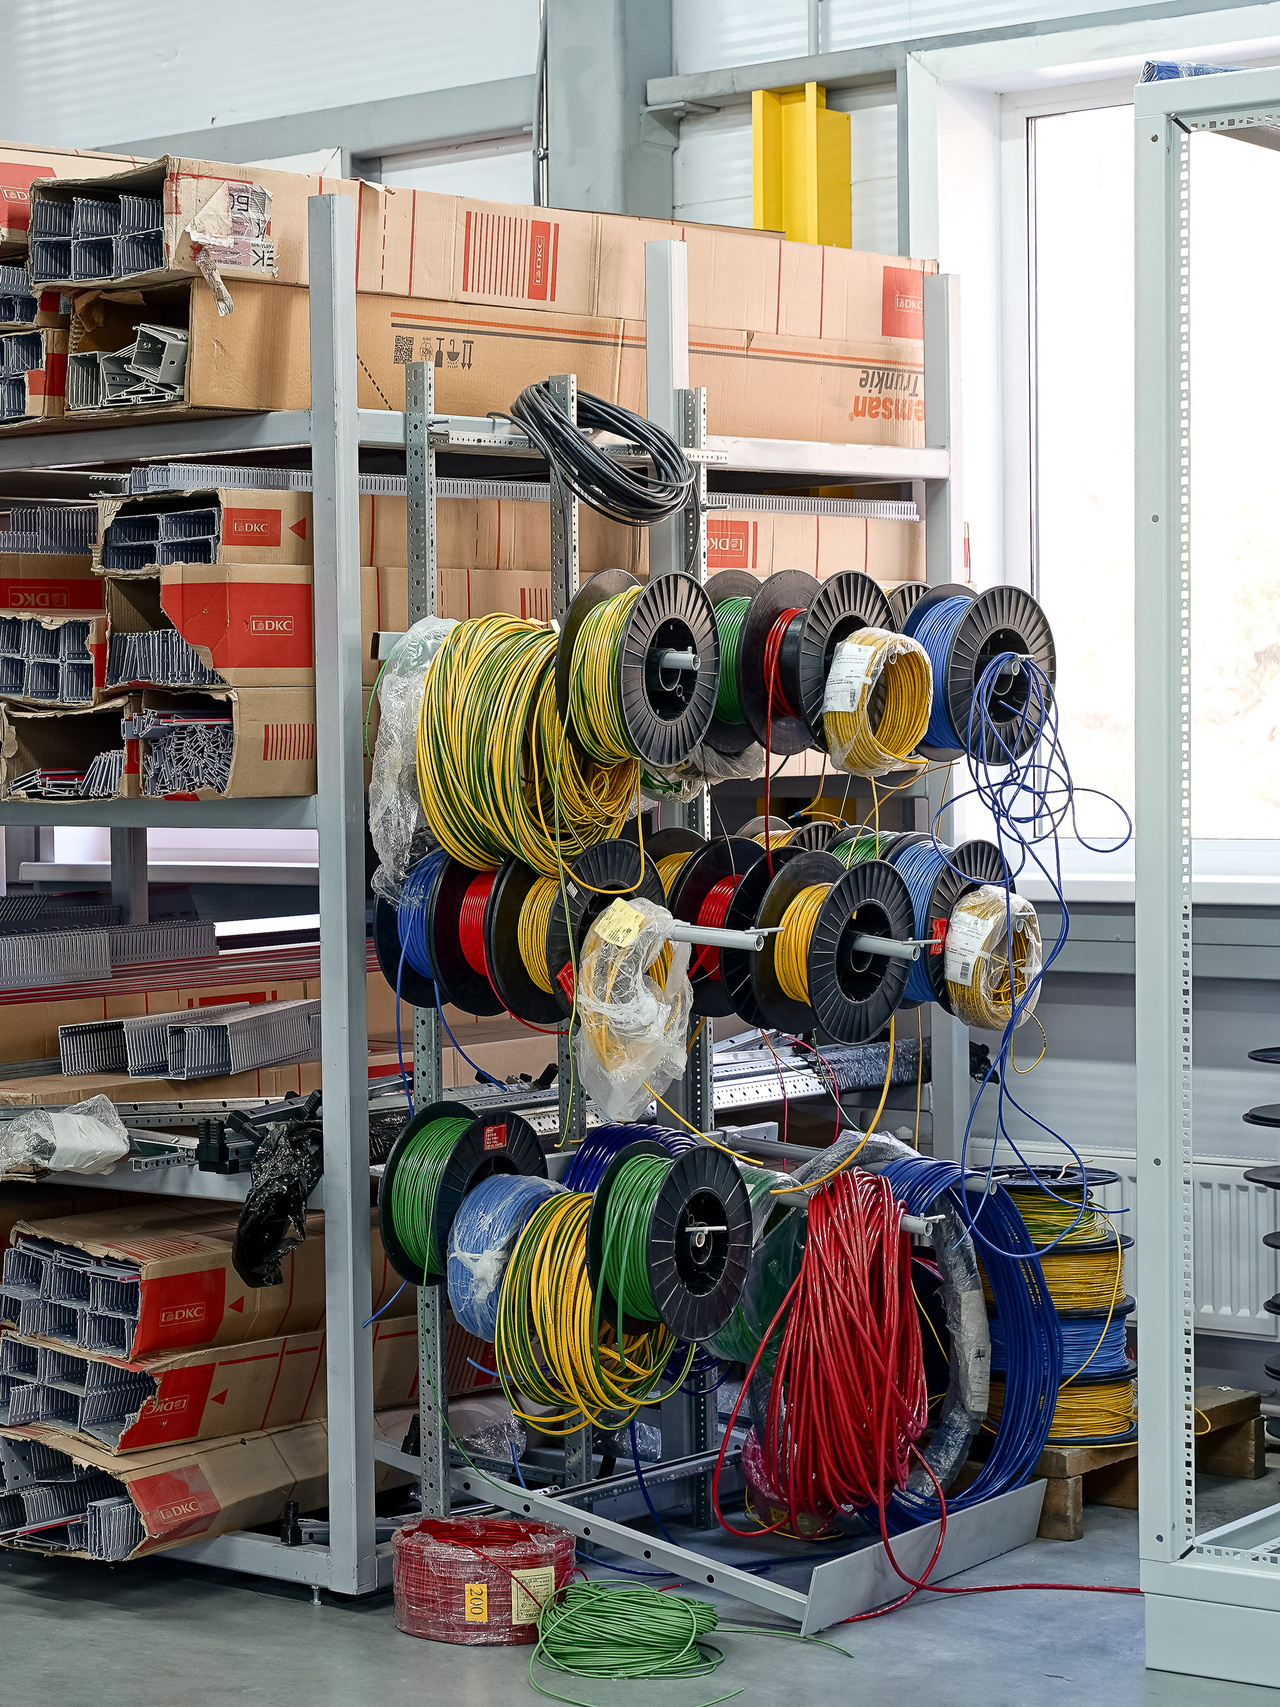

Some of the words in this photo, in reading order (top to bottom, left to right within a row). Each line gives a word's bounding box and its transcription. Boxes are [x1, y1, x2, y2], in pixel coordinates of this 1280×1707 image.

[536, 238, 544, 269] DKC
[859, 369, 919, 397] Trunkie
[853, 395, 925, 422] emsan
[245, 522, 269, 533] DKC
[709, 537, 729, 550] DK
[11, 592, 50, 606] DKC
[265, 620, 293, 631] DKC
[174, 1306, 204, 1320] DKC
[146, 1402, 174, 1414] DKC
[171, 1499, 200, 1517] DKC
[469, 1587, 484, 1616] 200
